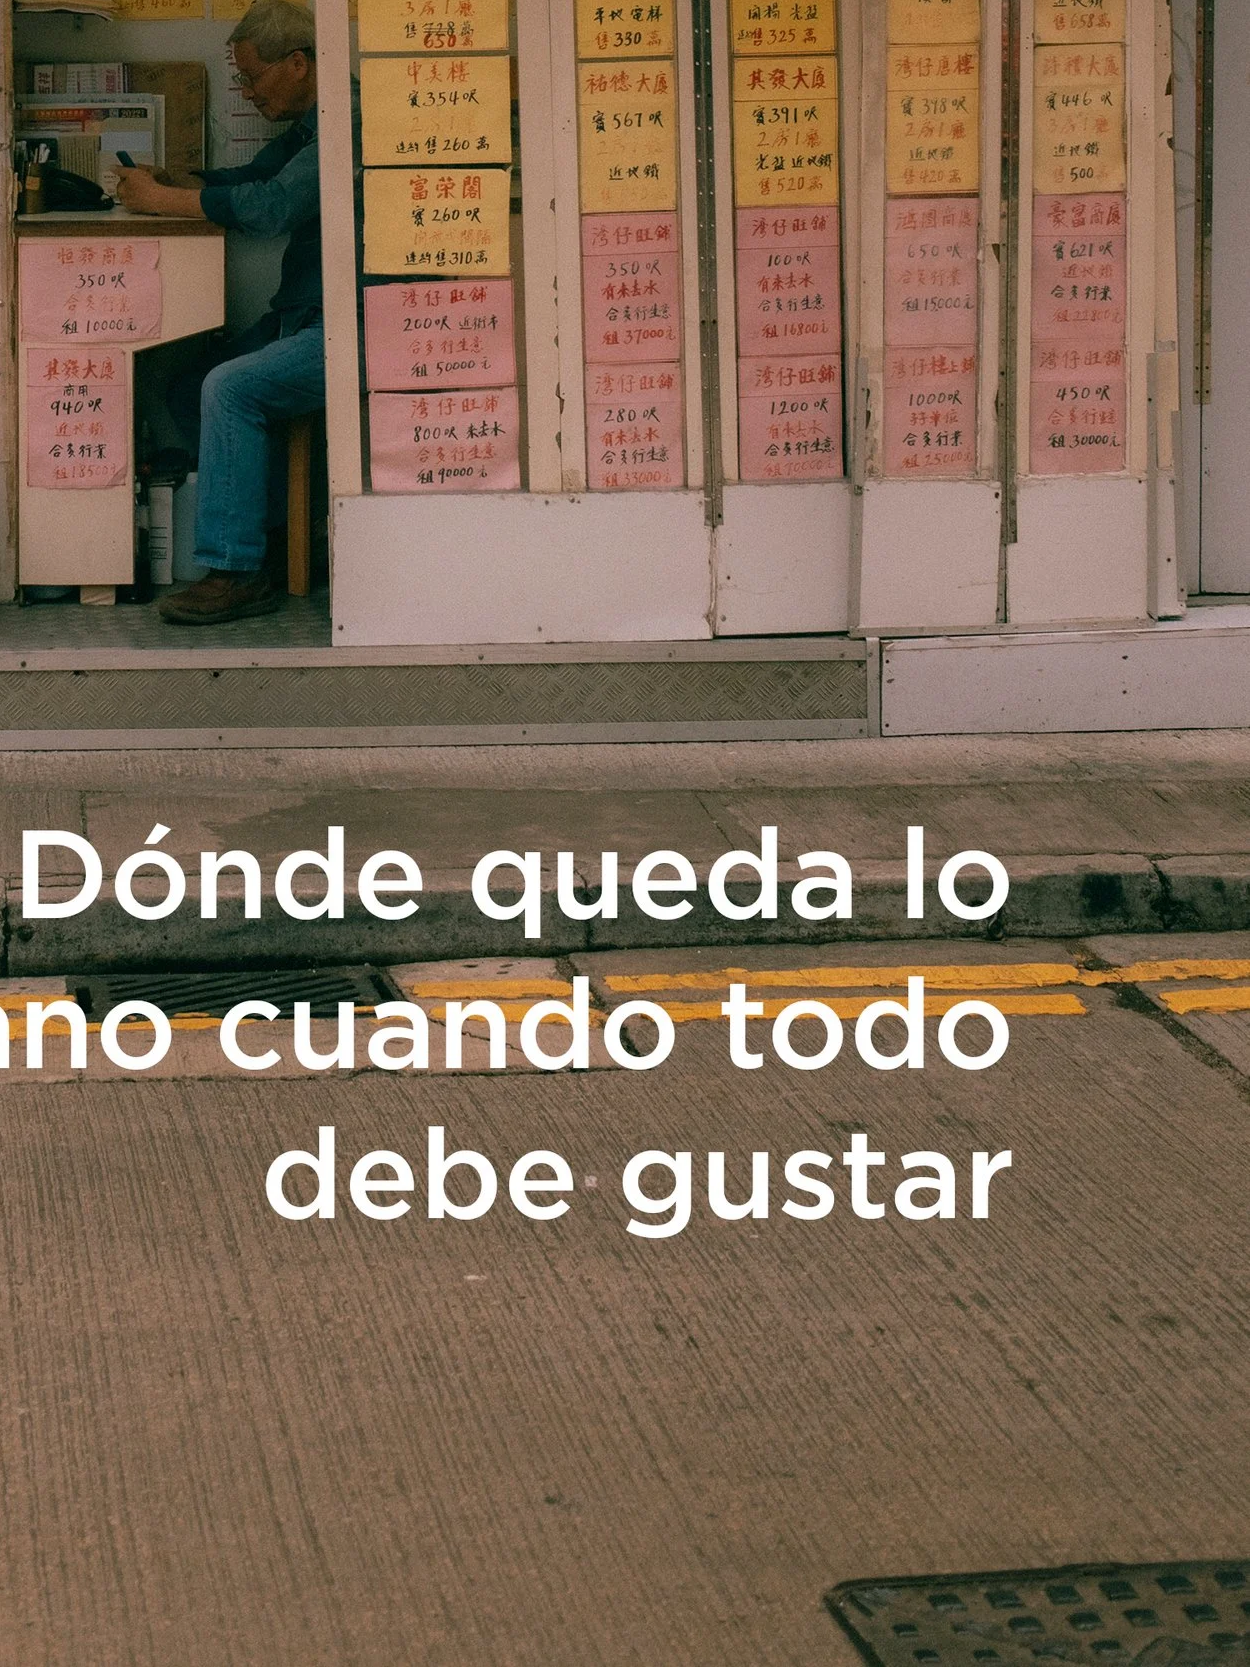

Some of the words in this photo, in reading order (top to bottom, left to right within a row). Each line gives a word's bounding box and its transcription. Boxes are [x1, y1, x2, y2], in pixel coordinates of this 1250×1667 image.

[768, 251, 811, 267] 100呎
[606, 260, 661, 278] 350呎
[75, 272, 126, 288] 350呎
[1056, 385, 1110, 401] 450呎
[772, 399, 829, 416] 1200呎
[604, 409, 660, 423] 280呎
